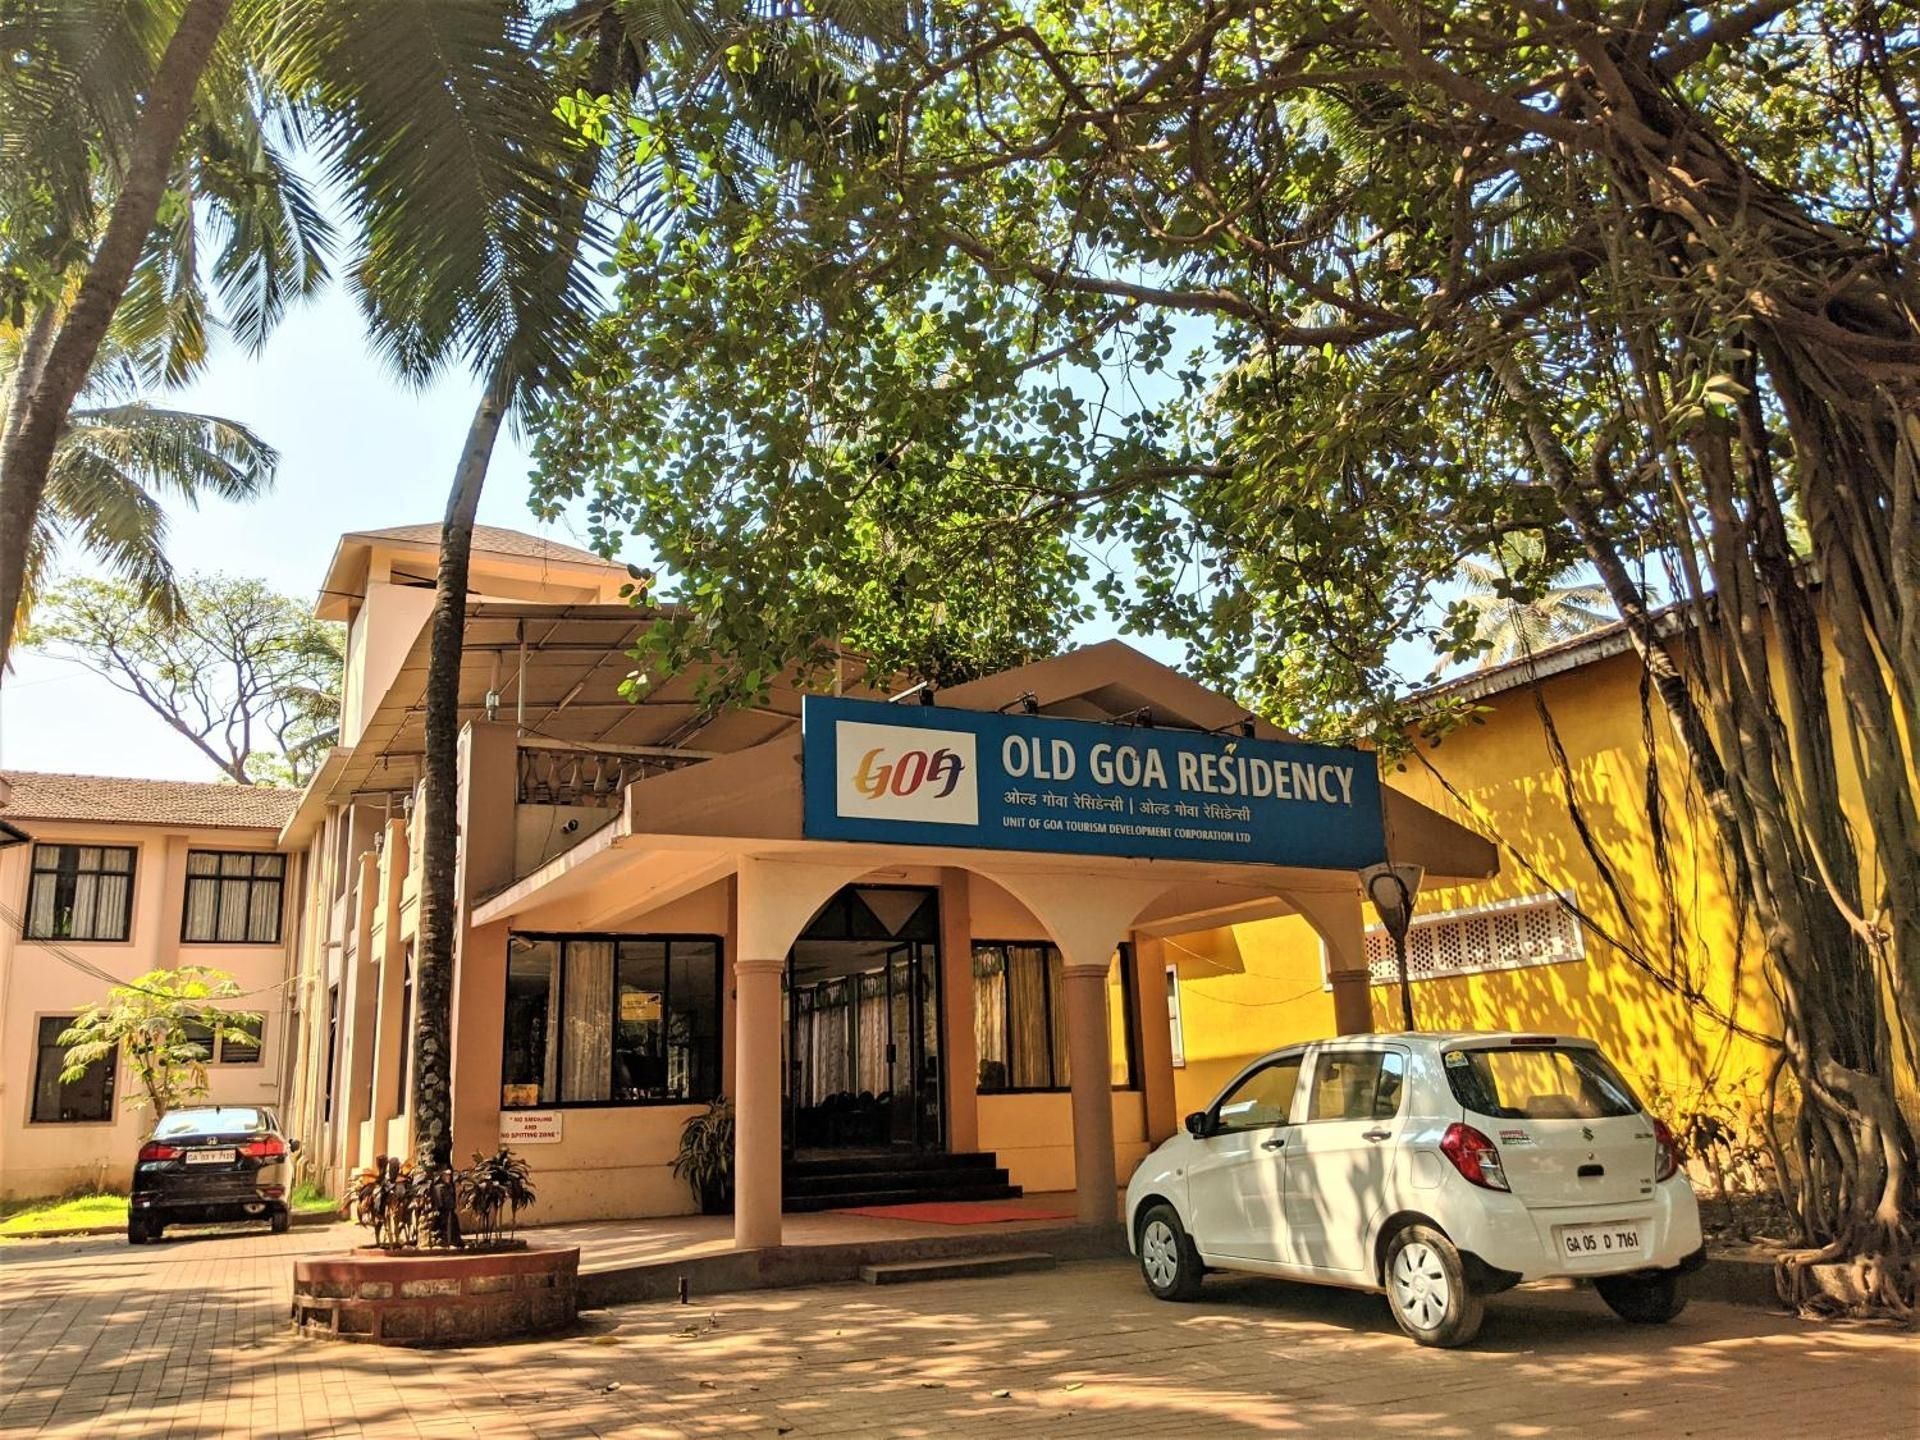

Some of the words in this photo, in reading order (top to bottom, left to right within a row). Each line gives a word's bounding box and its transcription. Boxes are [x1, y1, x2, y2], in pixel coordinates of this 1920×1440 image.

[852, 747, 966, 800] GOA
[1002, 734, 1077, 781] OLD
[1089, 742, 1168, 790] GOA
[1178, 750, 1353, 805] RESIDENCY
[1003, 788, 1037, 806] ओल्ड
[1042, 790, 1068, 809] गोवा
[1073, 792, 1124, 812] रेसिडेन्सी
[1139, 799, 1171, 817] ओल्ड
[1174, 800, 1199, 818] गोवा
[1003, 816, 1025, 828] UNIT
[1028, 818, 1042, 829] OF
[1043, 819, 1064, 831] GOA
[1066, 821, 1107, 834] TOURISM
[1109, 825, 1172, 838] DEVELOPMENT
[1174, 829, 1235, 842] CORPORATION
[1236, 832, 1251, 843] LTD
[1566, 1236, 1581, 1252] GA
[1583, 1234, 1597, 1250] 05
[1603, 1234, 1612, 1249] D
[1615, 1231, 1639, 1248] 7161
